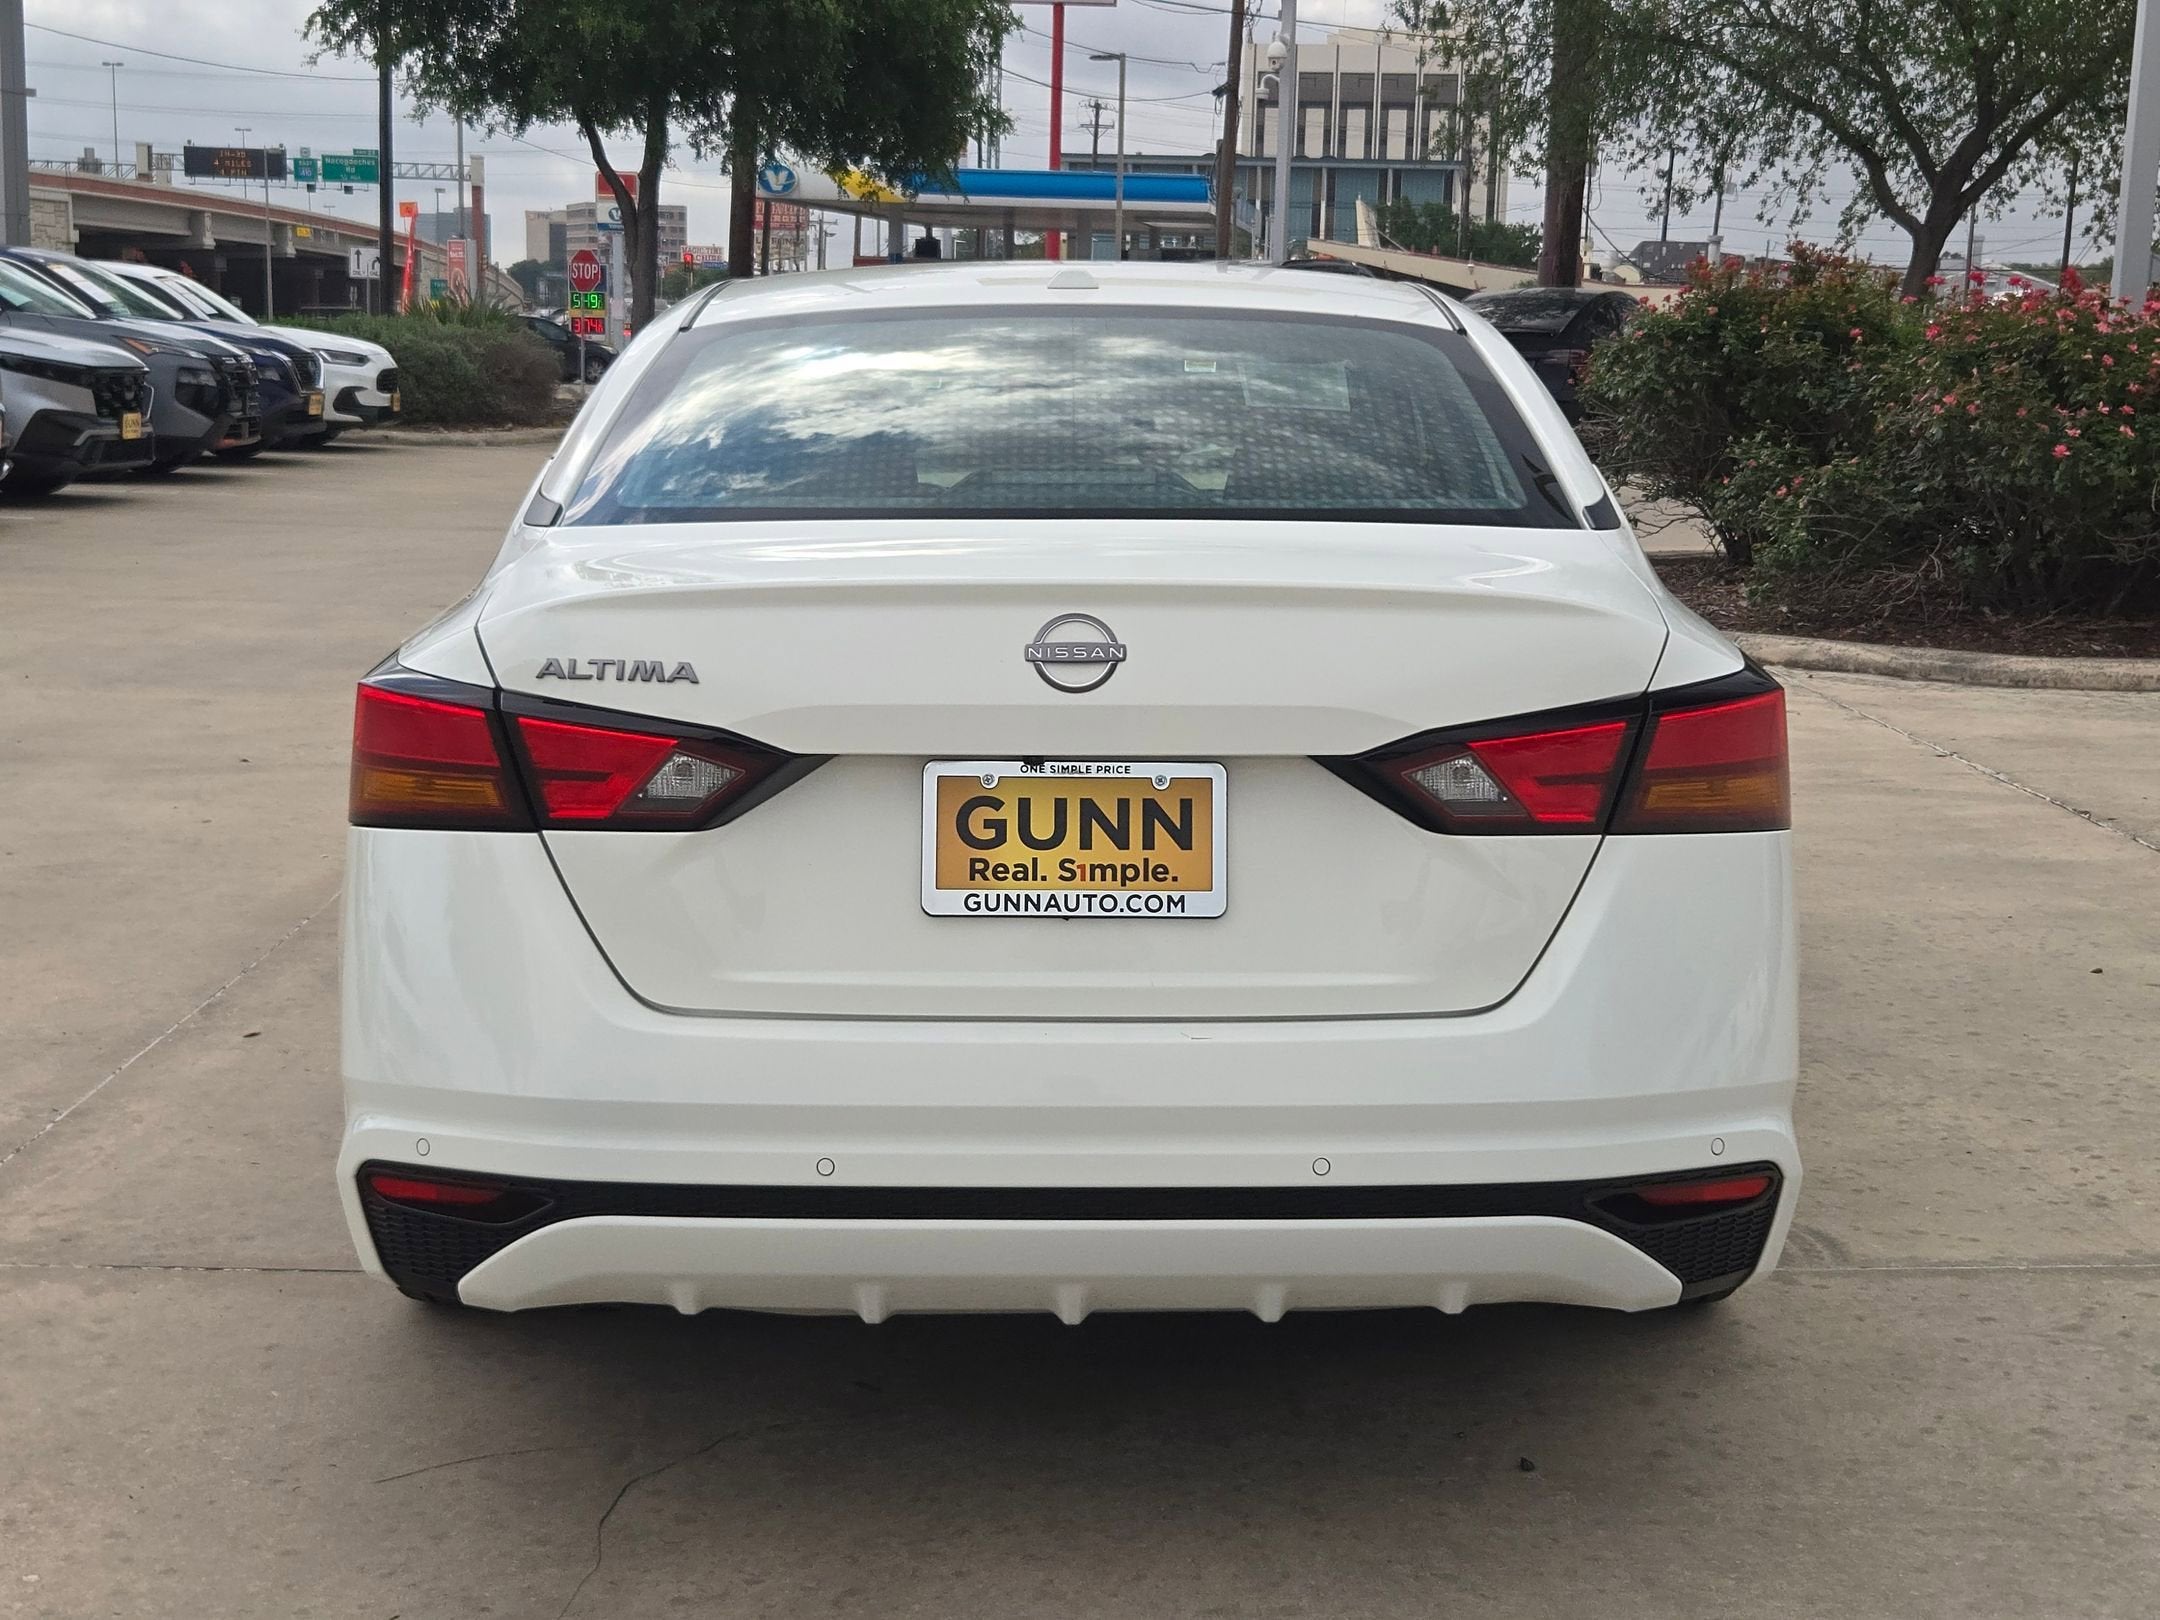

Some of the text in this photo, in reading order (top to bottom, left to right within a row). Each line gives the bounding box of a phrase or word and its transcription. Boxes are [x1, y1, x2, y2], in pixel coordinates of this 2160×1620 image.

[224, 160, 253, 168] MILES
[325, 158, 376, 166] Nacogdoches
[572, 263, 599, 280] STOP
[1028, 647, 1124, 659] NISSAN
[535, 657, 700, 685] ALTIMA
[1020, 764, 1131, 774] ONE SIMPLE PRICE
[955, 795, 1194, 852] GUNN
[968, 857, 1048, 882] Real.
[963, 892, 1186, 914] GUNNAUTO.COM
